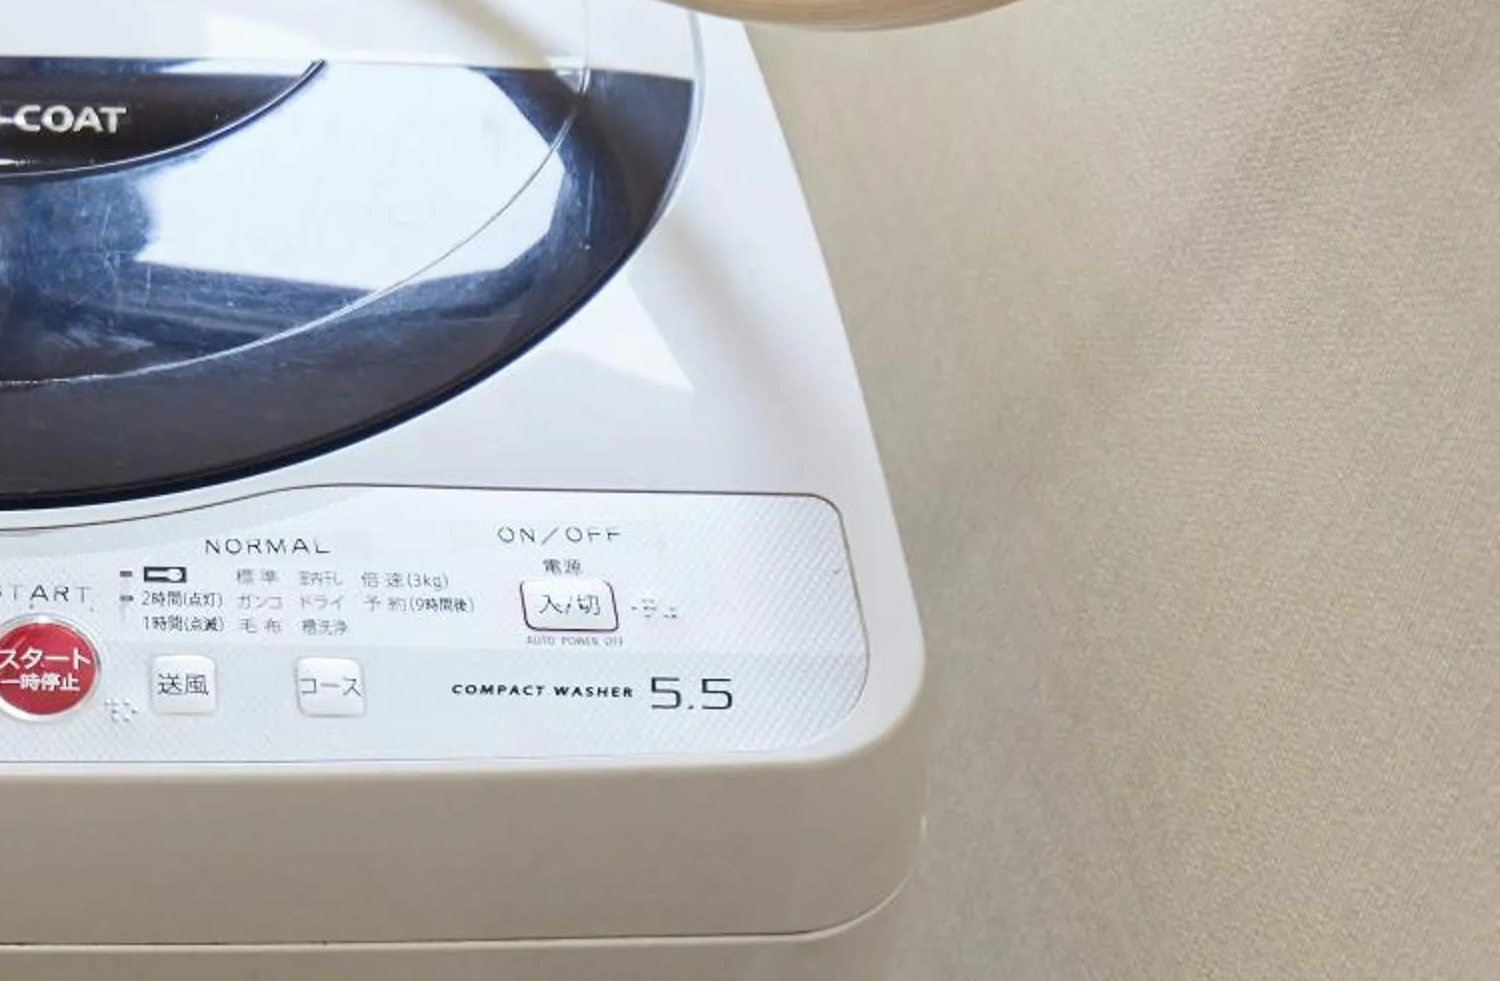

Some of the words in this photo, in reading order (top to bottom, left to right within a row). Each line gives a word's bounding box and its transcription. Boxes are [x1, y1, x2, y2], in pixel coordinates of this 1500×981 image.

[13, 104, 128, 134] COAT
[496, 526, 622, 546] ON/OFF
[204, 537, 332, 555] NORMAL
[541, 558, 583, 575] 電源
[235, 568, 280, 585] 標準
[236, 594, 284, 611] ガンコ
[298, 594, 344, 611] ドライ
[239, 617, 283, 635] 毛布
[0, 672, 82, 692] 一時停止
[156, 672, 210, 696] 送風
[299, 674, 364, 697] コース
[451, 683, 546, 697] COMPACT
[553, 685, 635, 699] WASHER
[650, 676, 733, 711] 5.5
